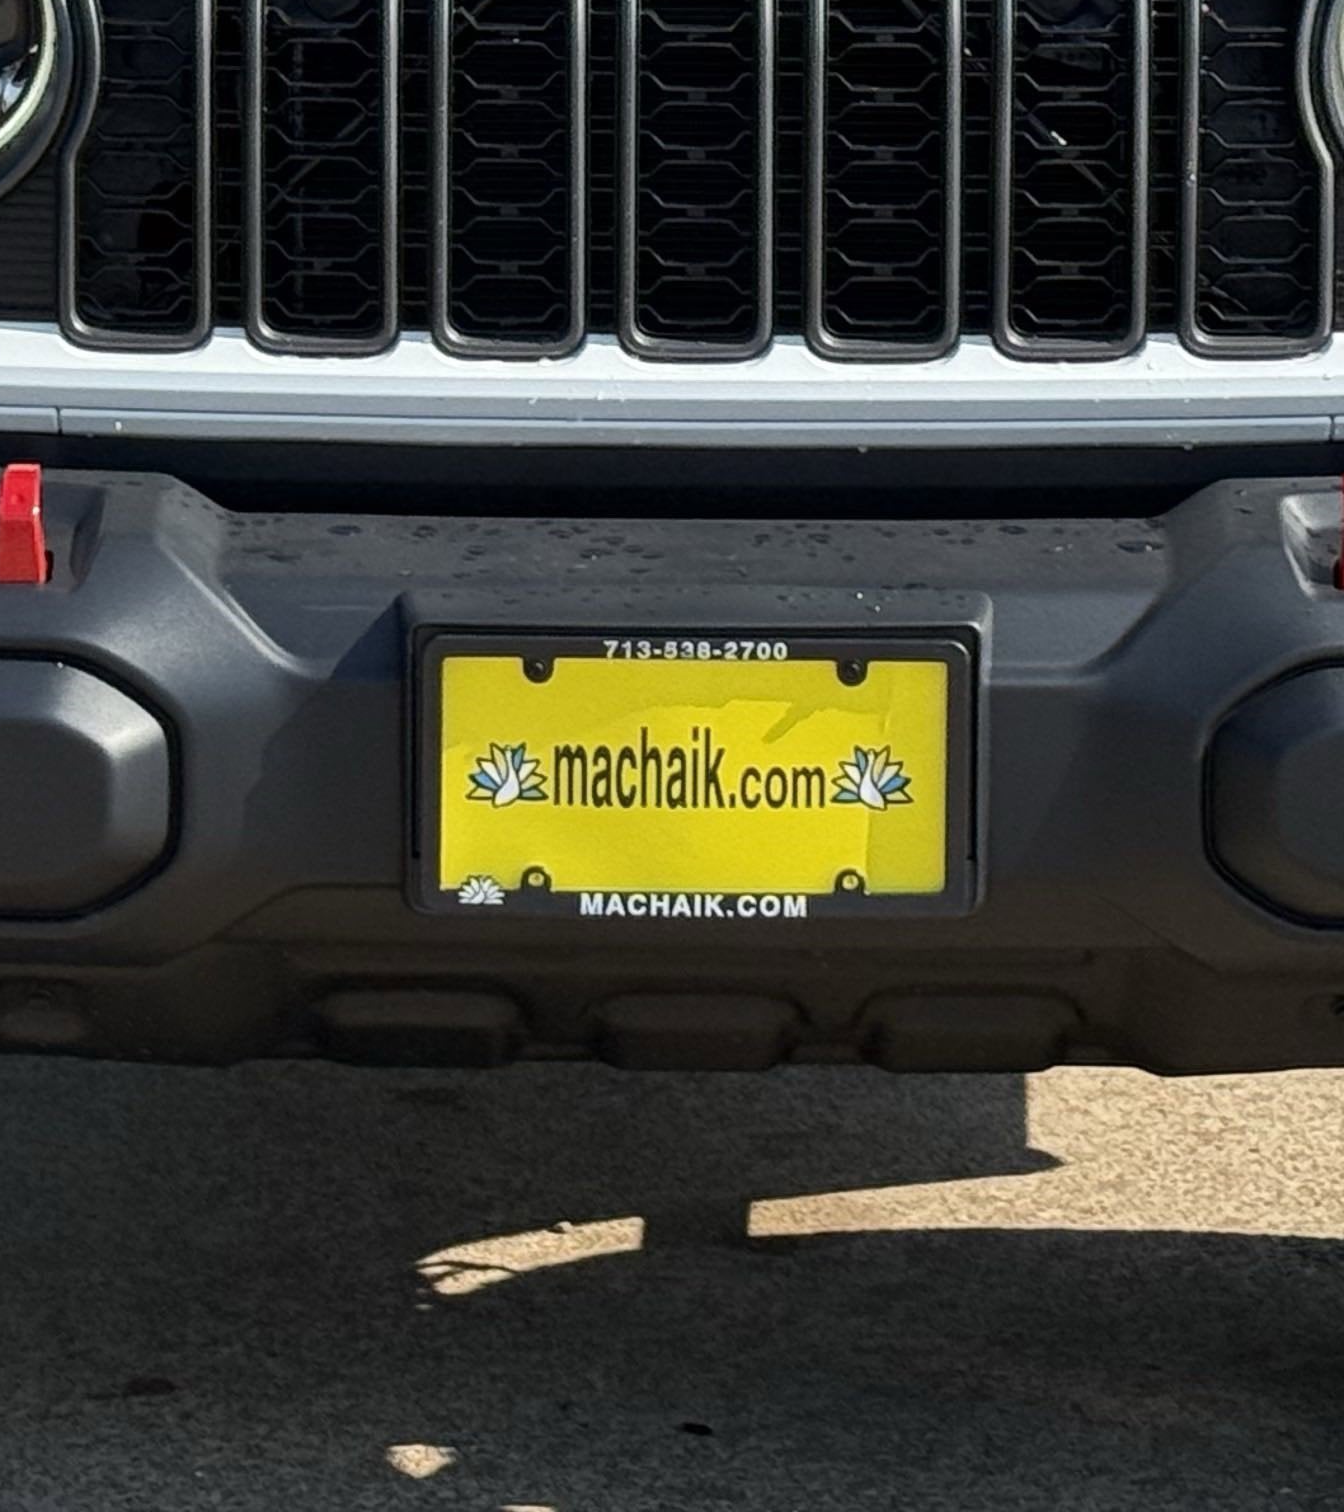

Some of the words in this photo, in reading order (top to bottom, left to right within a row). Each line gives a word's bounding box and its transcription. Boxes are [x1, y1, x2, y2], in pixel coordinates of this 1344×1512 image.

[603, 640, 788, 660] 713-538-2700
[552, 726, 826, 809] machaik.com
[579, 894, 808, 918] MACHAIK.COM
